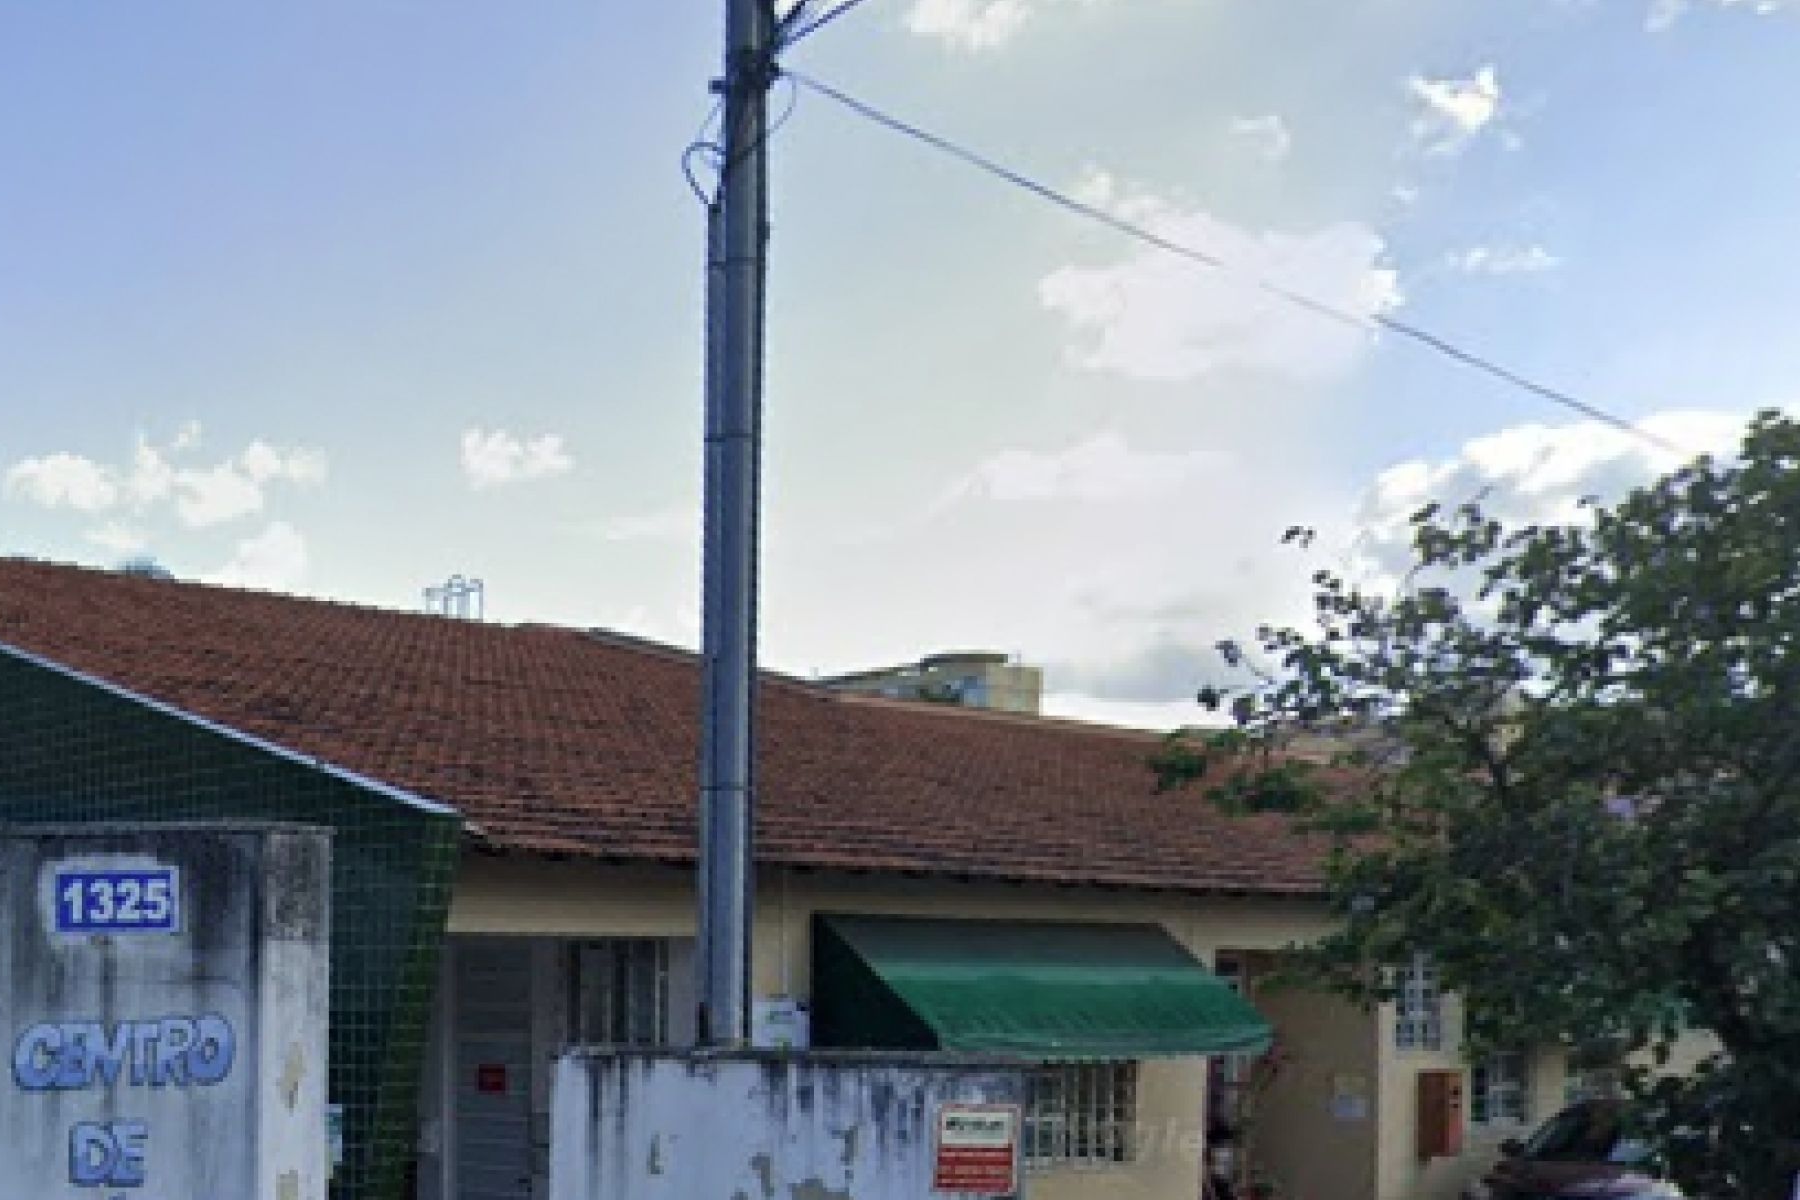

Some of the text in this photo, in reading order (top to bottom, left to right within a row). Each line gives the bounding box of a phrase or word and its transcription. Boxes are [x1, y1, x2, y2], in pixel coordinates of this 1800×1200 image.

[62, 878, 170, 922] 1325
[12, 1011, 234, 1092] CENTRO
[69, 1118, 149, 1187] DE
